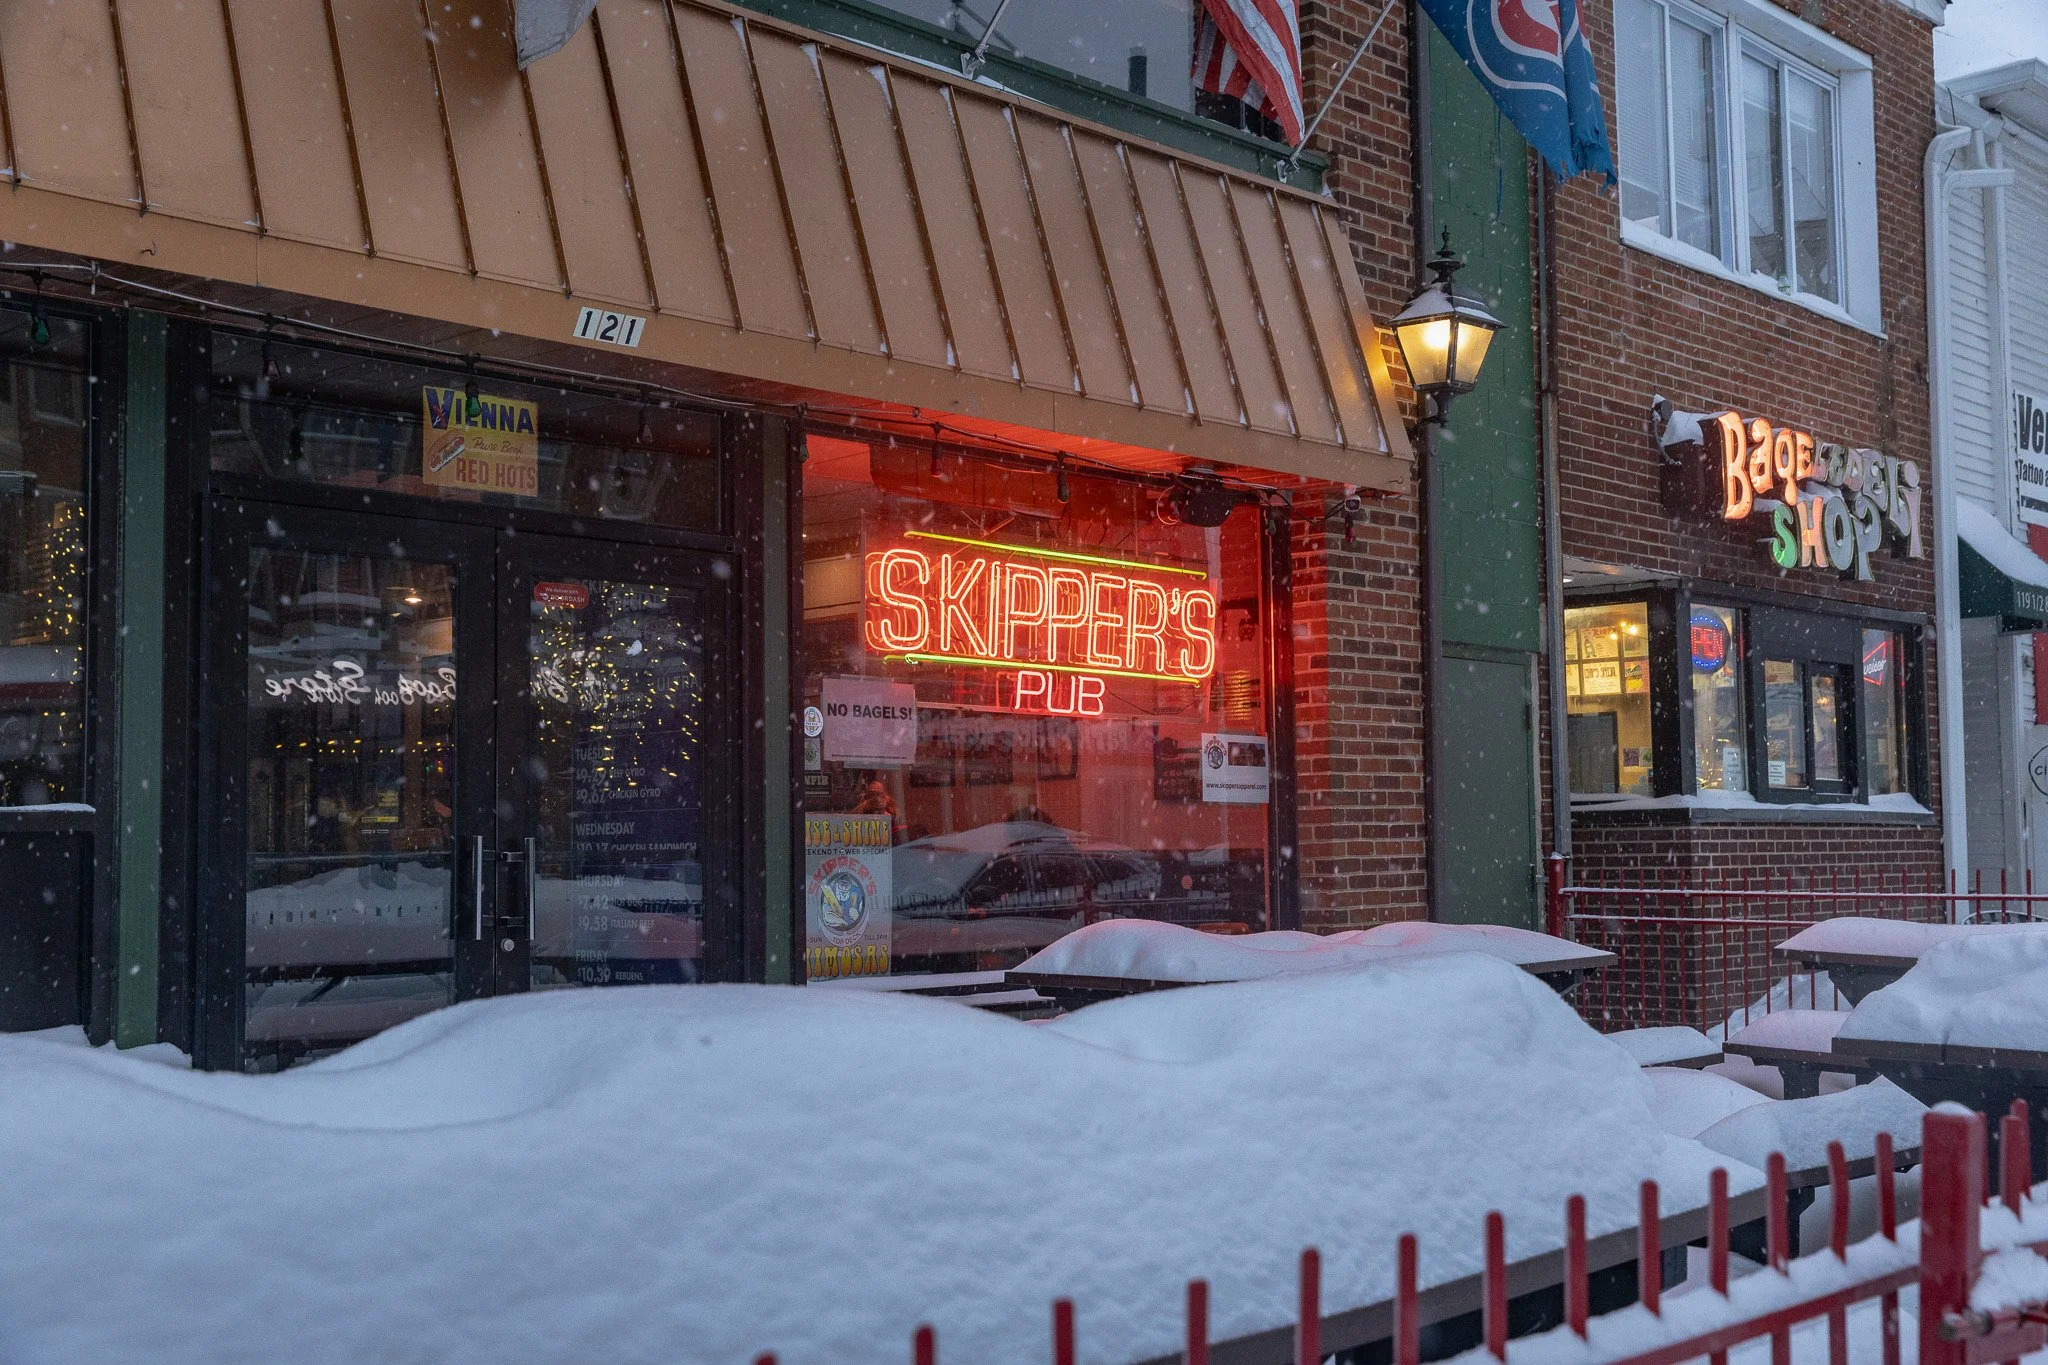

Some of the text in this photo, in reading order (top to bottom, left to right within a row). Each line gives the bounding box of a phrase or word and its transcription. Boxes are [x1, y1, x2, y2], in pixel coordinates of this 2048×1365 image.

[581, 311, 637, 345] 121
[2017, 394, 2048, 455] Ve
[472, 437, 523, 460] Pure Beef
[456, 457, 536, 489] RED HOTS
[2019, 458, 2044, 486] Tattoo
[1772, 493, 1876, 583] SHOP
[550, 595, 585, 603] DOORDASH
[880, 549, 1216, 678] SKIPPER'S
[1690, 627, 1724, 658] PEN
[1015, 670, 1105, 716] PUB
[827, 703, 913, 721] NO BAGELS!
[608, 789, 639, 800] CHICKEN
[639, 787, 661, 798] GYRO
[1206, 783, 1267, 791] www.skippersapparel.com
[576, 821, 635, 836] WEDNESDAY
[805, 819, 832, 847] ISE
[842, 820, 890, 847] SHINE
[576, 874, 625, 887] THURSDAY
[578, 915, 608, 931] $9.58
[575, 949, 608, 962] FRIDAY
